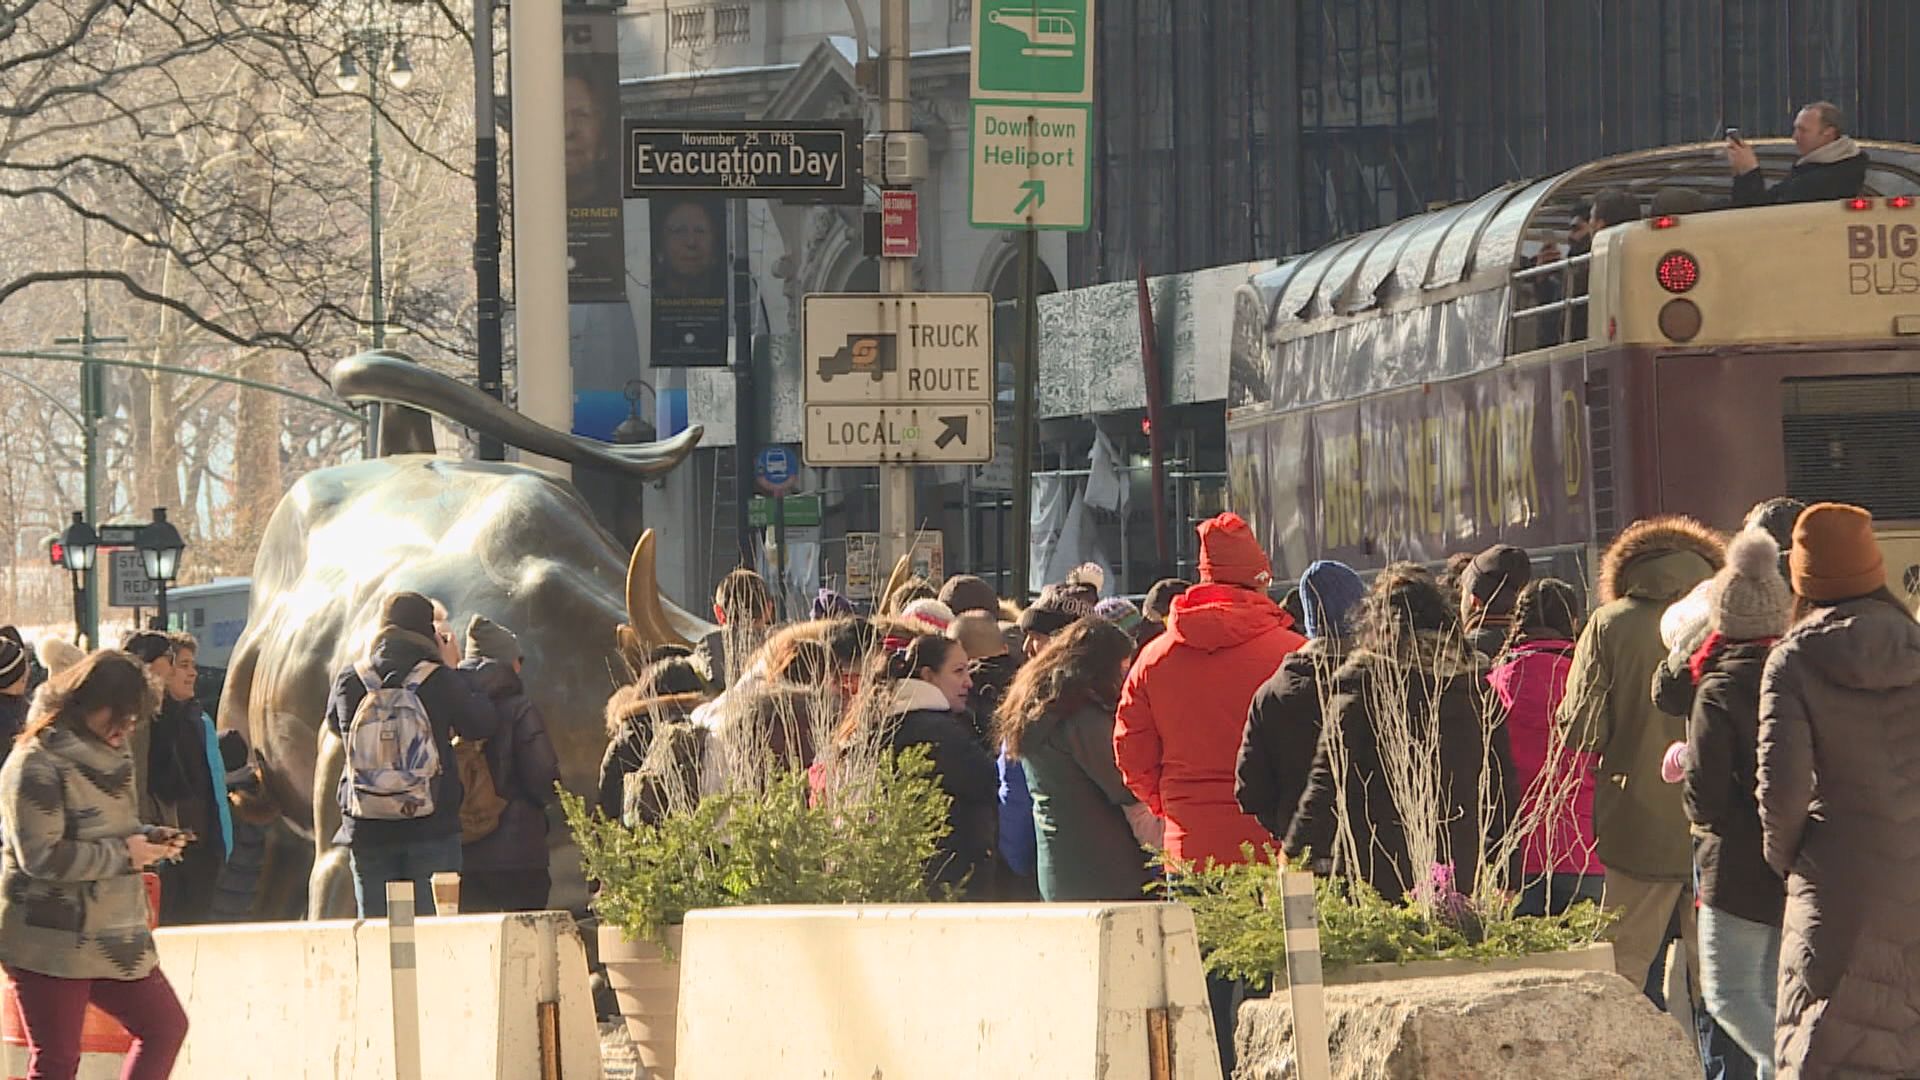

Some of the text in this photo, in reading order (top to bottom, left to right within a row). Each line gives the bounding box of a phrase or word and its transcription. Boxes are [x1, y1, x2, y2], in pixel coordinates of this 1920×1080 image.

[984, 116, 1076, 138] Downtown
[682, 132, 736, 146] November
[770, 132, 795, 146] 1783
[638, 145, 838, 182] Evacuation Day
[983, 145, 1075, 169] Heliport
[720, 173, 756, 187] PLAZA
[567, 207, 619, 217] ORMER
[1848, 224, 1918, 259] BIG
[1849, 262, 1919, 295] BUS
[908, 324, 979, 347] TRUCK
[908, 368, 980, 391] ROUTE
[827, 422, 901, 445] LOCAL
[123, 580, 152, 593] RED
